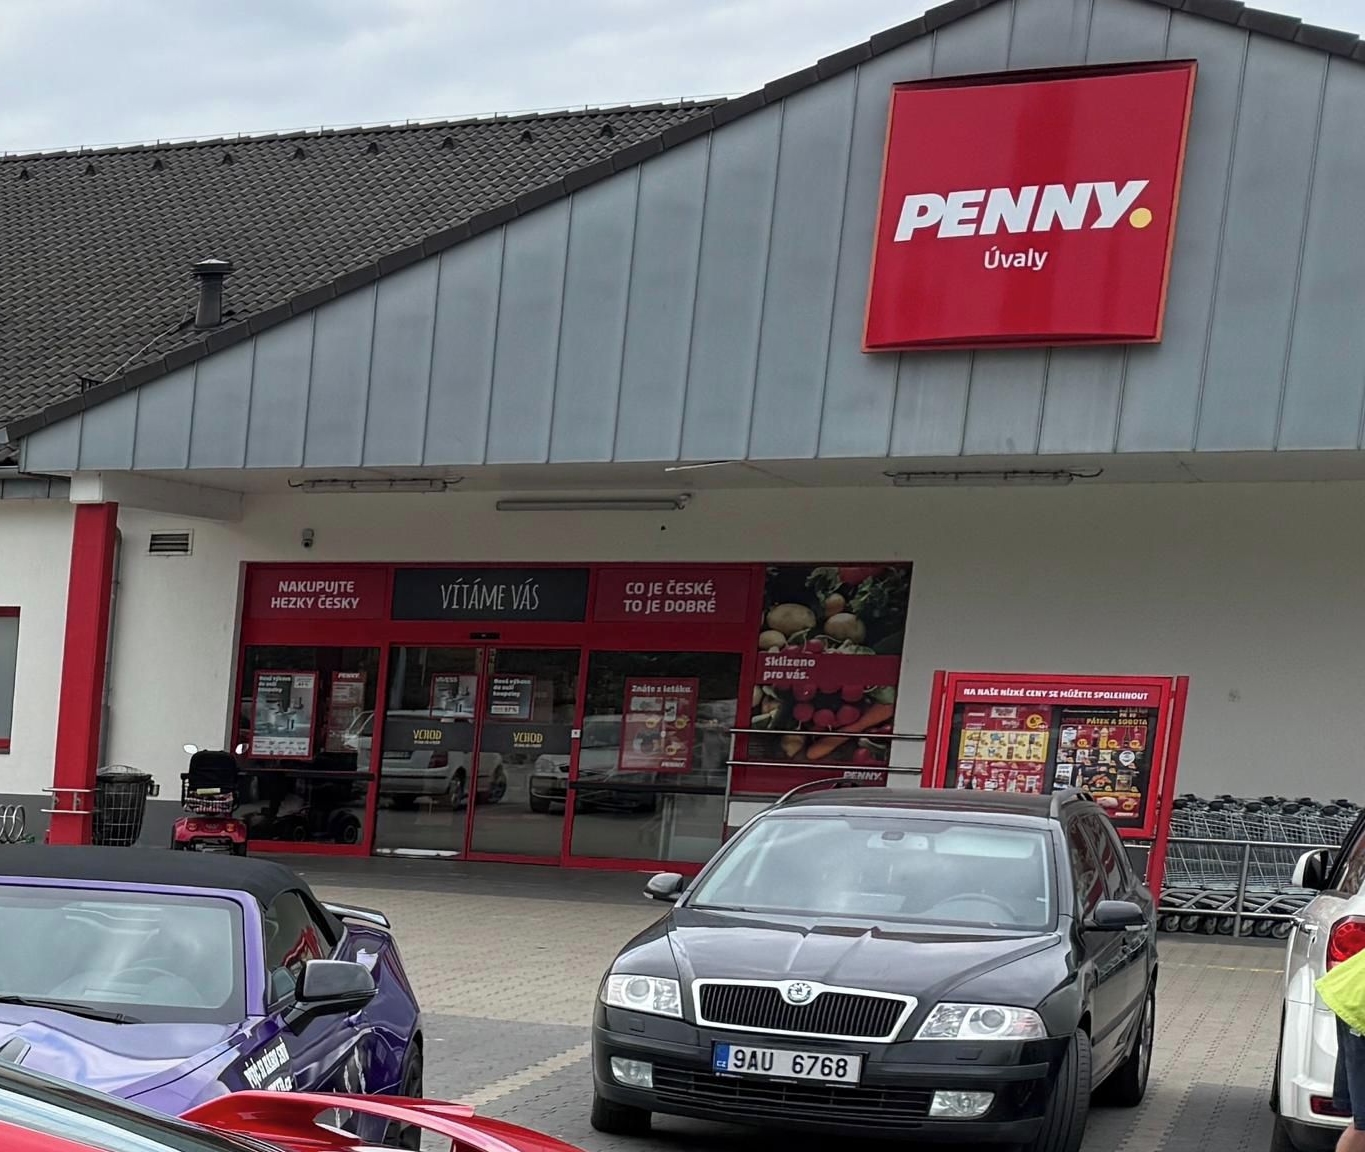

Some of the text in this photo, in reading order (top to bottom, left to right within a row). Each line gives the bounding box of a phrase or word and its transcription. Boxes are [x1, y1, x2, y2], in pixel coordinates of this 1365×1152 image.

[984, 246, 1048, 271] Úvaly
[278, 580, 355, 594] NAKUPUJTE
[440, 577, 540, 610] VÍTÁME VÁS
[625, 579, 717, 597] CO JE ČESKÉ,
[270, 595, 360, 609] HEZKY ČESKY
[623, 598, 717, 615] TO JE DOBRÉ
[764, 656, 816, 667] Sklizeno
[763, 669, 810, 681] pro vás.
[631, 684, 655, 693] Znáte
[964, 687, 1149, 700] NA NAŠE NÍZKÉ CENY SE MŮŽETE SPOLEHNOUT
[716, 1049, 848, 1078] CZ 9AU 6768
